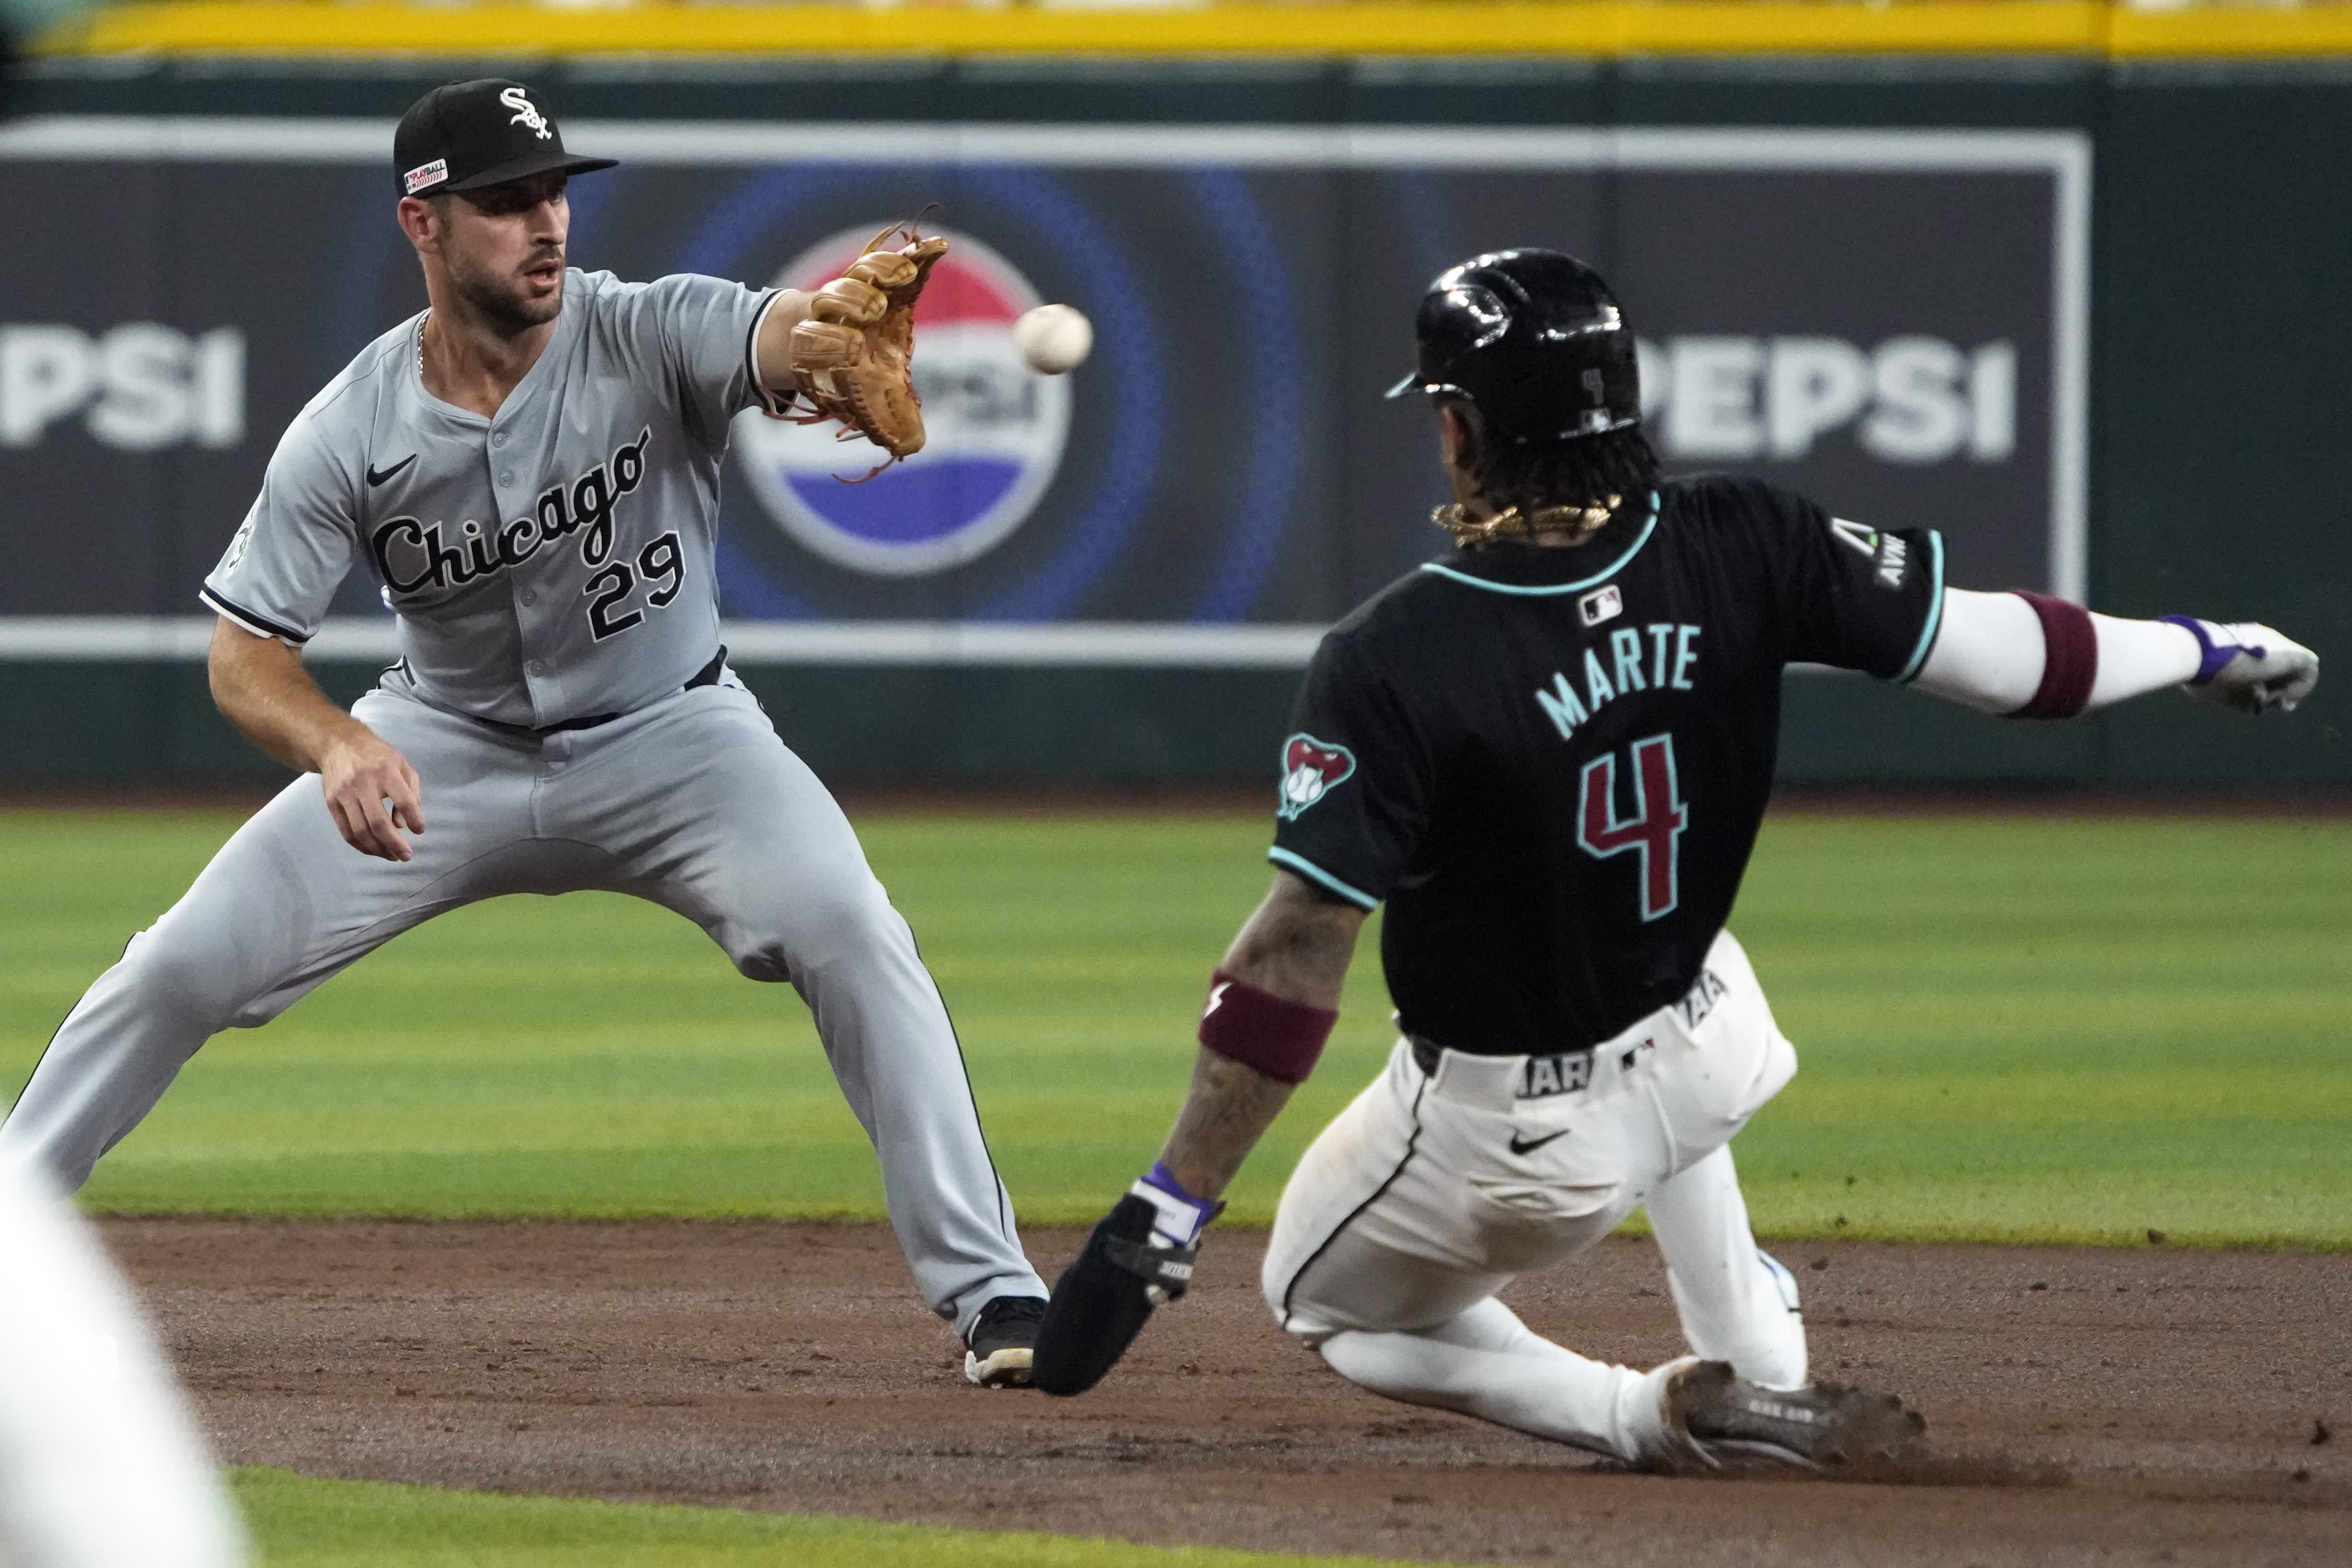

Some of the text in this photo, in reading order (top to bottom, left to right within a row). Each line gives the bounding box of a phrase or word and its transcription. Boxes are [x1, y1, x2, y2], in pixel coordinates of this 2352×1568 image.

[0, 322, 245, 449] PSI
[372, 423, 652, 594] Chicago
[583, 530, 687, 643] 29
[1535, 623, 1701, 741] MARTE
[1576, 732, 1689, 923] 4
